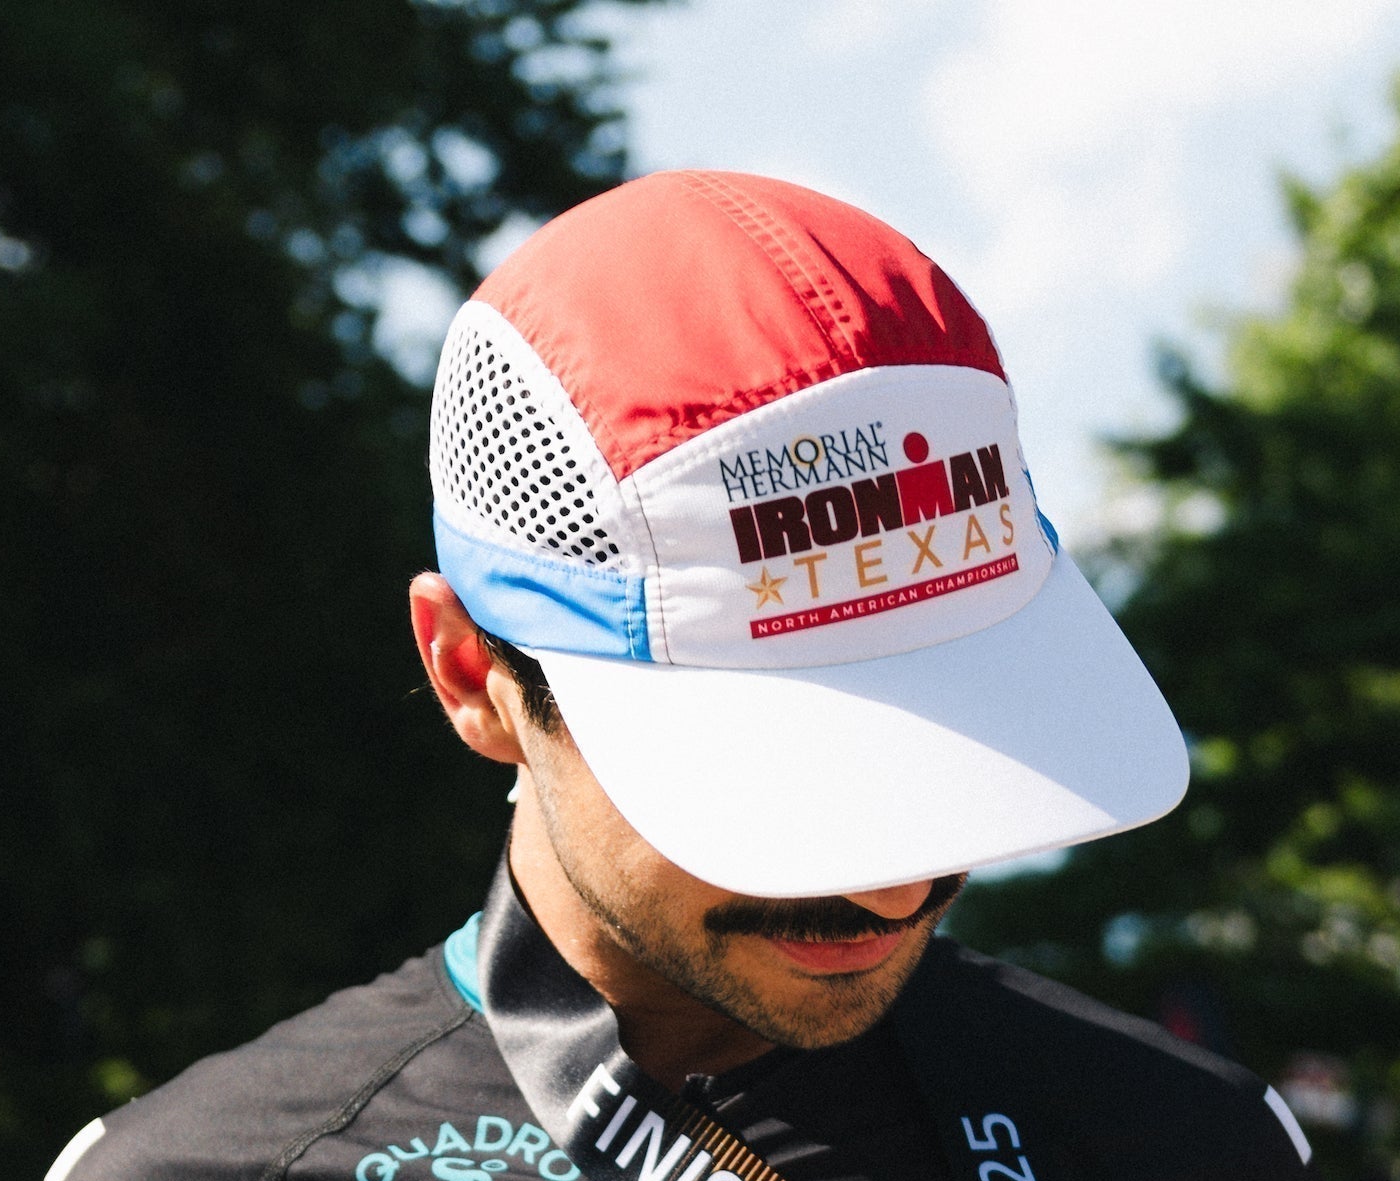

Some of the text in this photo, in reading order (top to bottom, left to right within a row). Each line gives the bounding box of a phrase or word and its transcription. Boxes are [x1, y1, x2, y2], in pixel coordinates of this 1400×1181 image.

[722, 444, 890, 502] HERMANN
[729, 432, 1010, 564] IRONMAN
[793, 503, 1015, 599] TEXAS
[757, 557, 1017, 635] NORTH AMERICAN CHAMPIONSHIP
